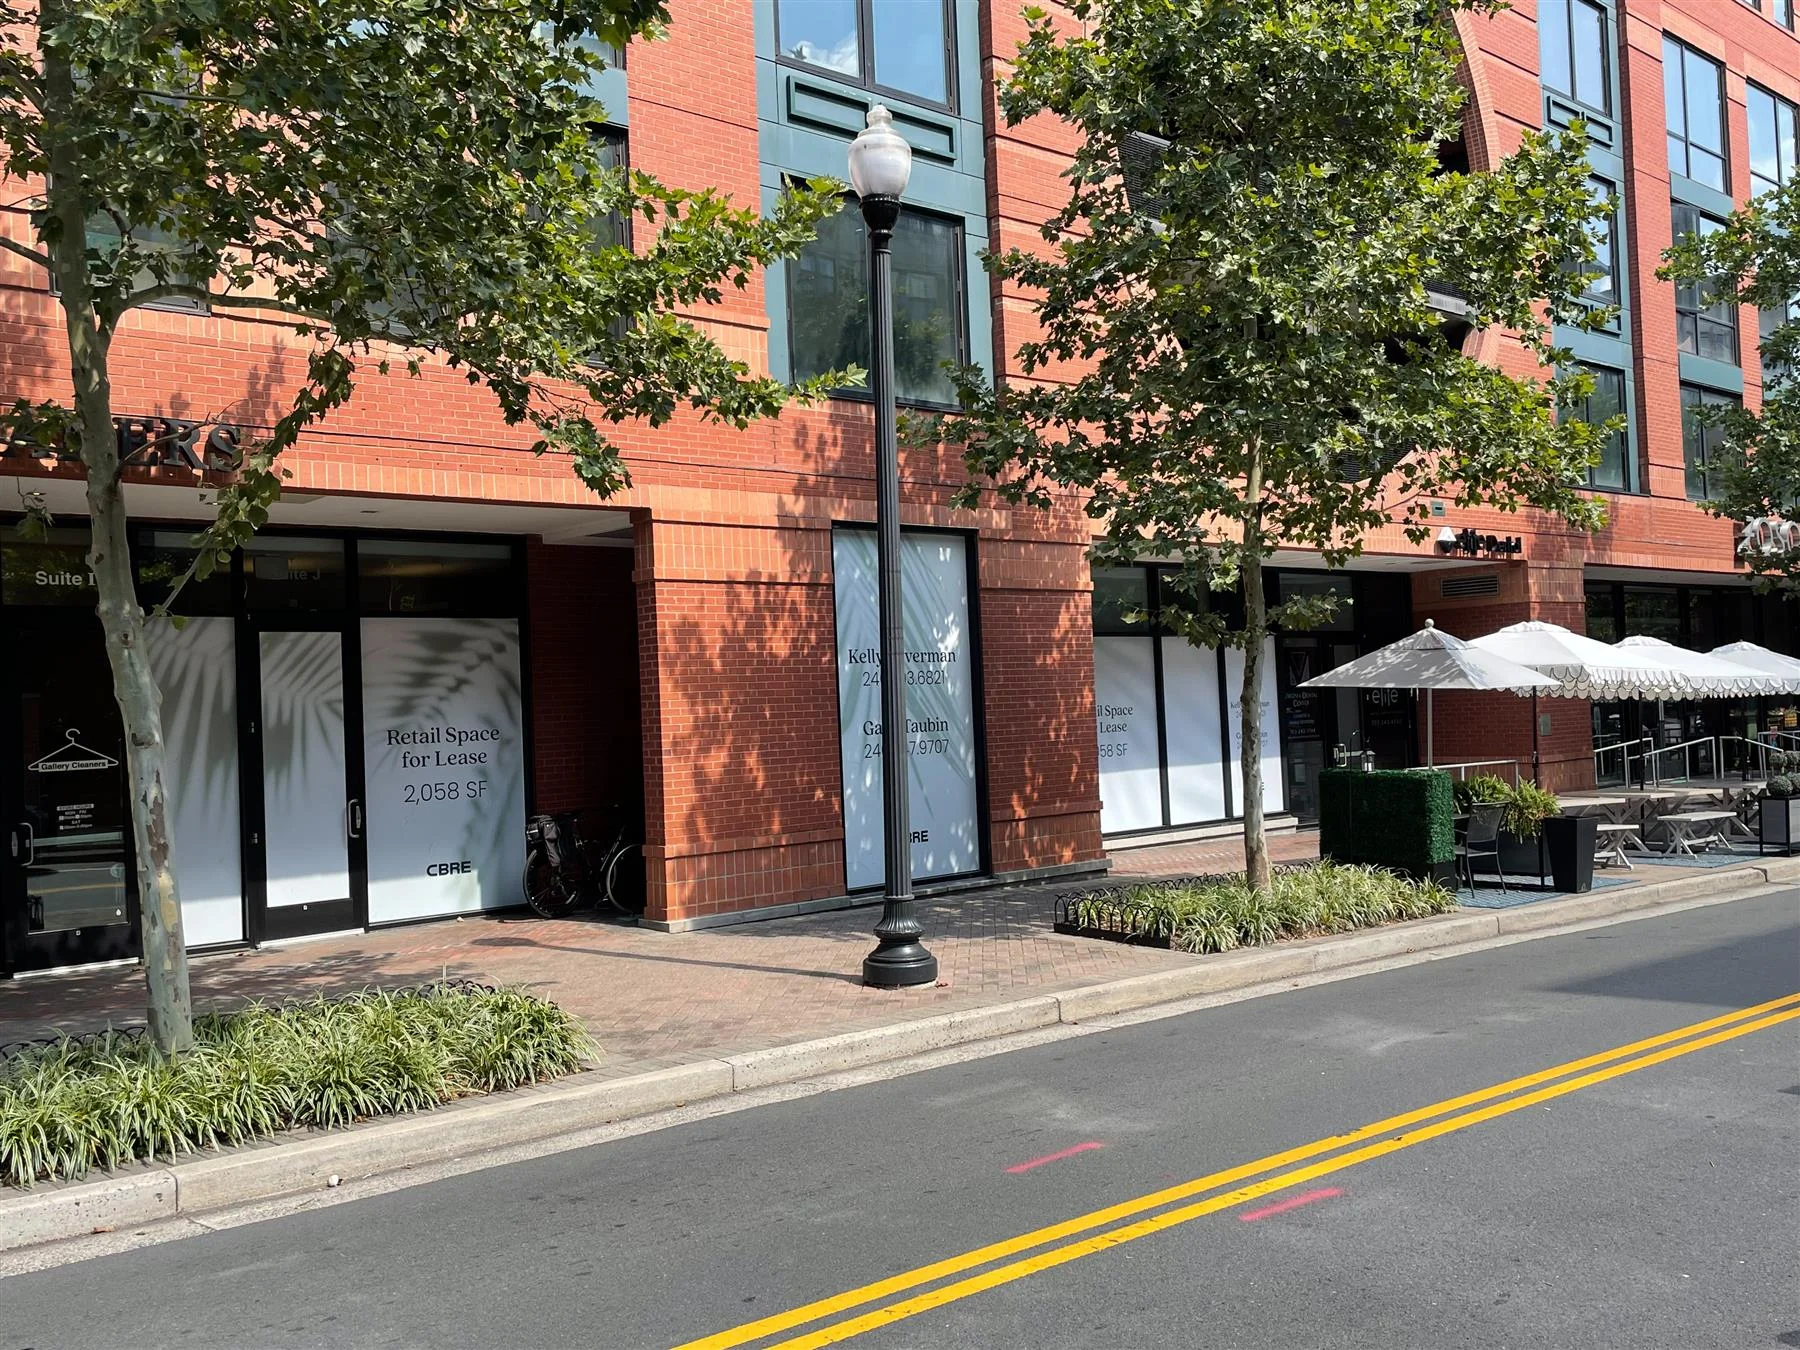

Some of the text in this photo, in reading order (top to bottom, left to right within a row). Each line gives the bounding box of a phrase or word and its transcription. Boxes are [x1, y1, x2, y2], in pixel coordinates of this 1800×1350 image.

[35, 570, 83, 586] Suite
[1104, 704, 1133, 719] Space
[386, 726, 500, 746] Retail Space
[1100, 722, 1127, 734] Lease
[1116, 743, 1128, 757] SF
[71, 761, 106, 769] Cleaners
[402, 750, 488, 768] for Lease
[404, 781, 487, 805] 2,058 SF
[426, 861, 472, 877] CBRE
